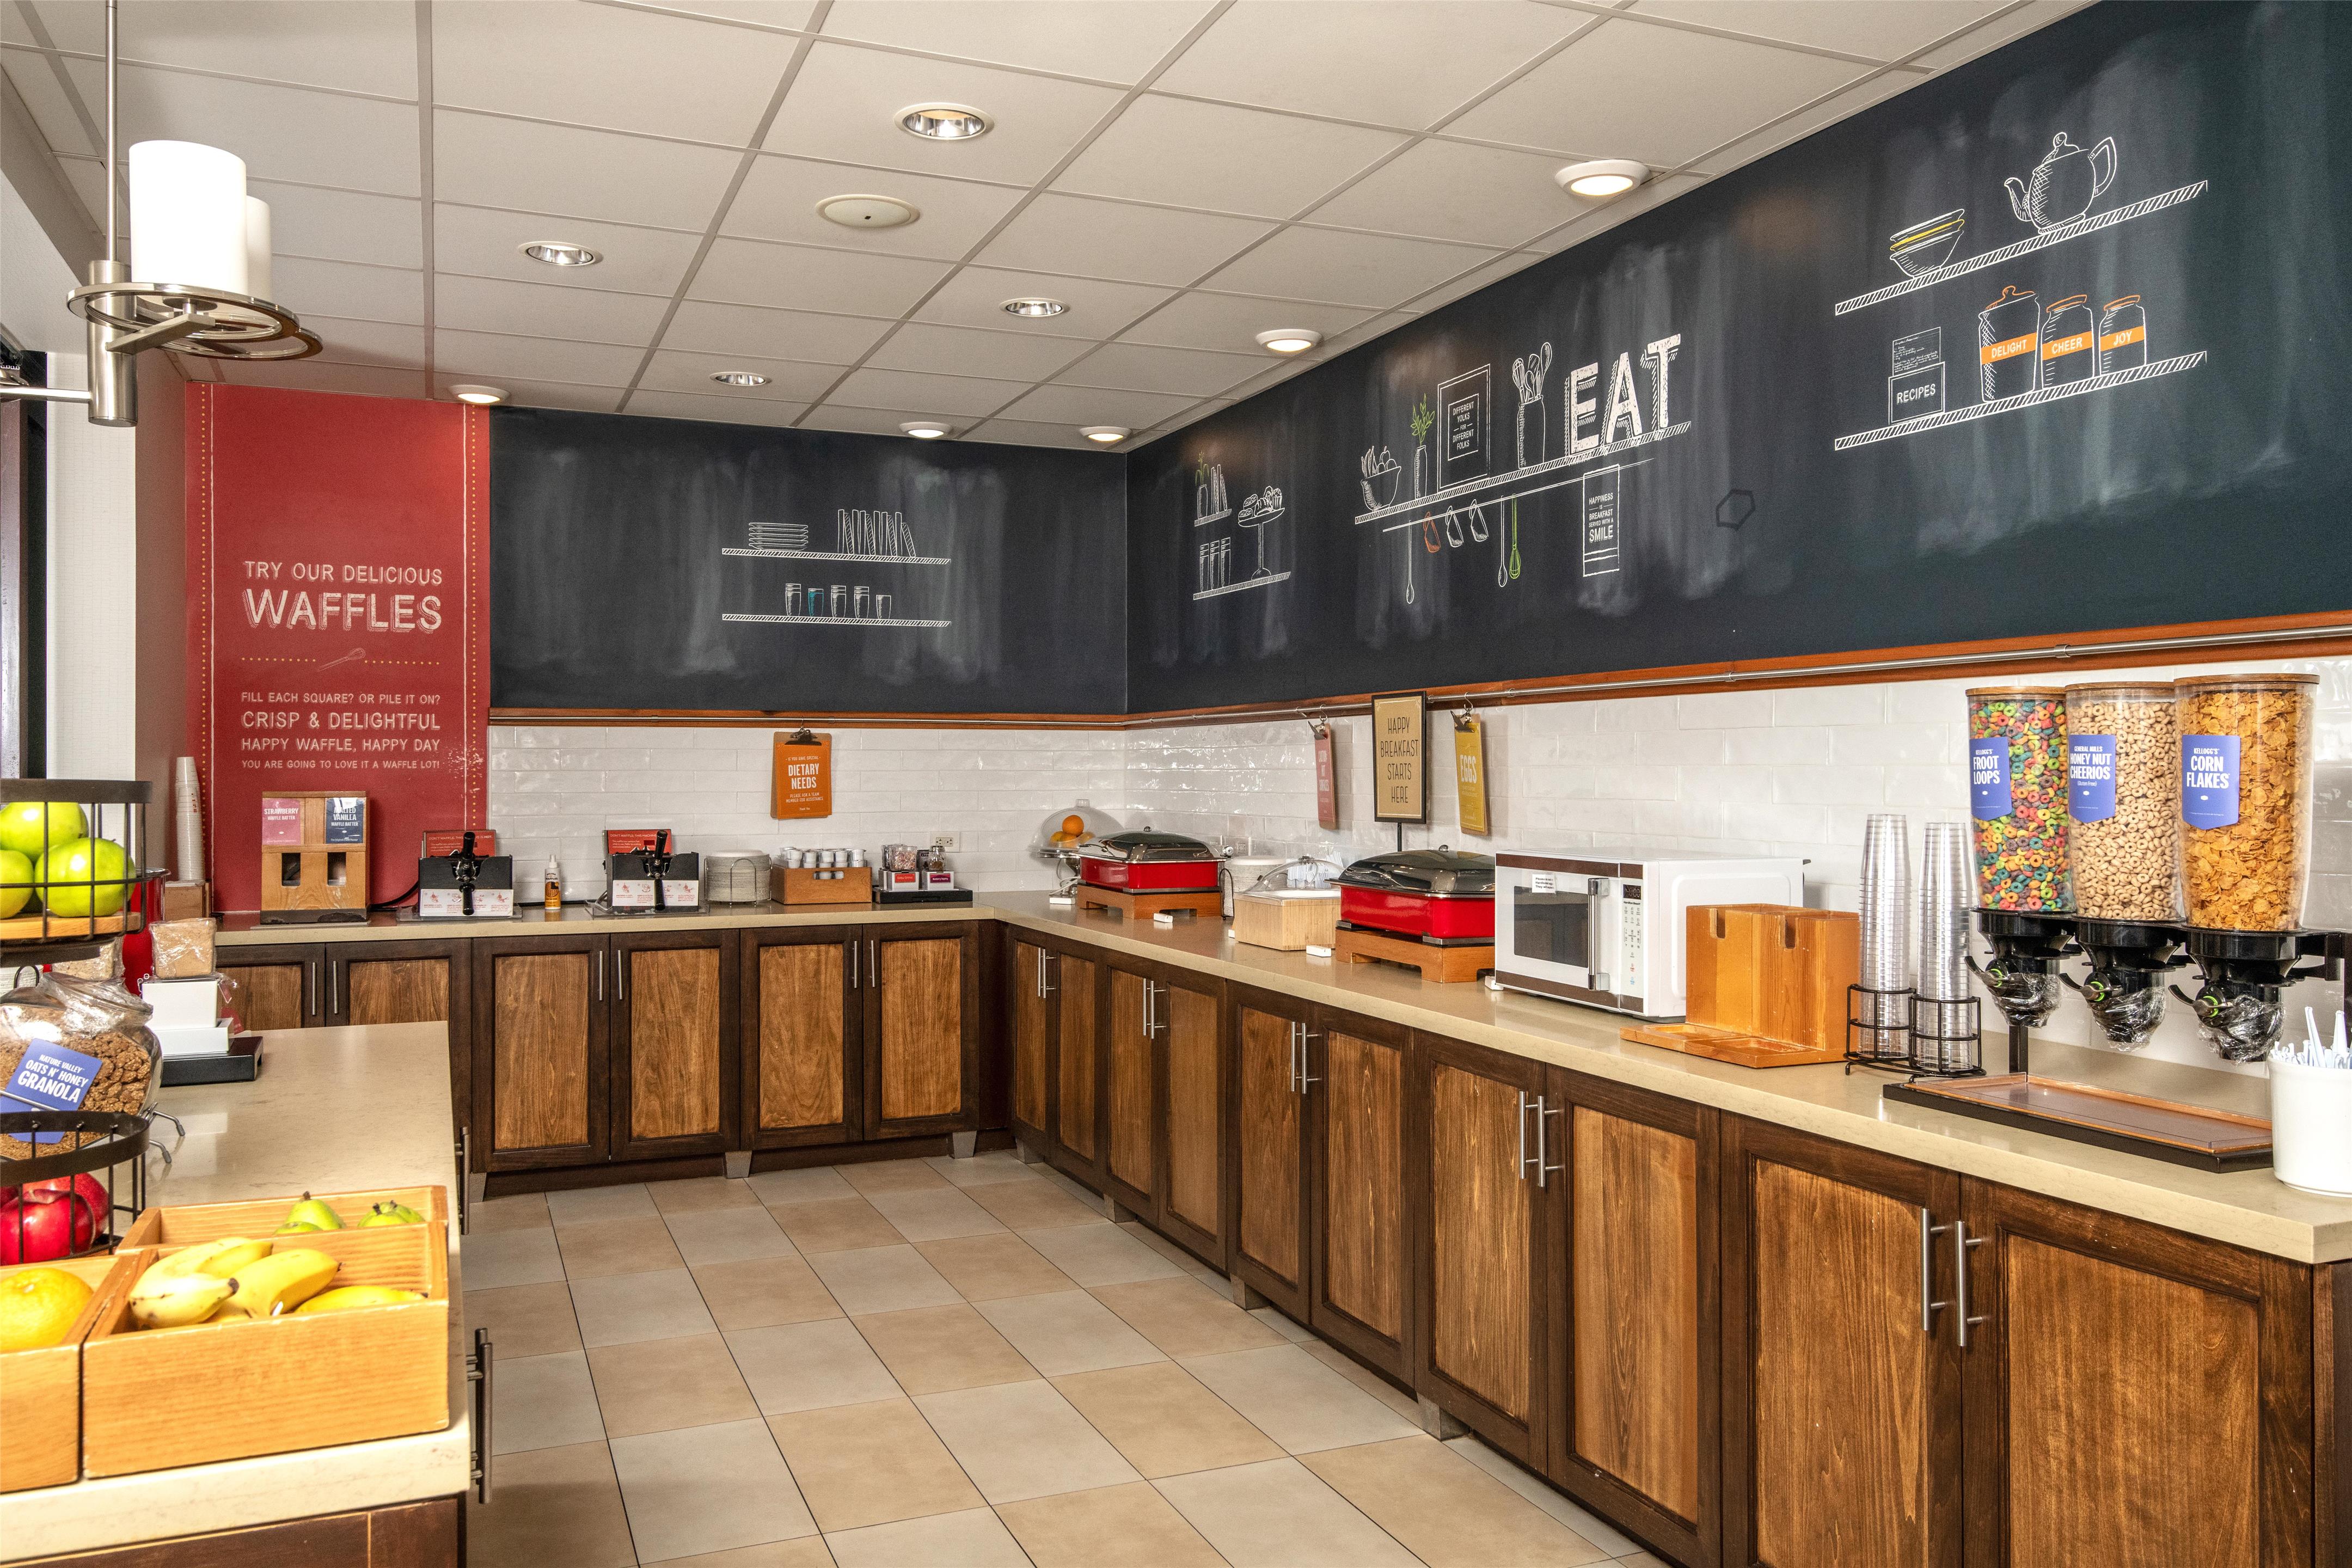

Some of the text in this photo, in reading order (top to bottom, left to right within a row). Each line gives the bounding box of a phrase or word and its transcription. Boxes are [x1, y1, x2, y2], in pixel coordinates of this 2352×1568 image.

[2051, 338, 2082, 354] CHEER
[2114, 332, 2133, 346] JOY
[1991, 339, 2027, 359] DELIGHT
[1565, 333, 1681, 455] EAT
[1896, 383, 1936, 405] RECIPES
[1453, 401, 1474, 415] DIFFERENT
[1457, 412, 1470, 422] YOLKS
[1453, 429, 1474, 443] DIFFERENT
[1457, 440, 1469, 450] FOLKS
[1589, 492, 1613, 505] HAPPINESS
[1589, 509, 1613, 520] BREAKFAST
[1589, 525, 1613, 543] SMILE
[243, 561, 442, 586] TRY OUR DELICIOUS
[242, 589, 442, 634] WAFFLES
[241, 693, 440, 705] FILL EACH SQUARE? OR PILE IT ON?
[242, 711, 440, 731] CRISP & DELIGHTFUL
[1388, 717, 1410, 734] HAPPY
[241, 738, 440, 752] HAPPY WAFFLE, HAPPY DAY
[1380, 739, 1418, 757] BREAKFAST
[242, 760, 261, 768] YOU
[265, 760, 283, 768] ARE
[287, 760, 316, 768] GOING
[320, 760, 331, 768] TO
[335, 761, 358, 769] LOVE
[420, 761, 439, 769] LOT!
[1973, 756, 1999, 770] FROOT
[2070, 753, 2112, 765] HONEY NUT
[2190, 756, 2224, 771] CORN
[788, 763, 819, 776] DIETARY
[1387, 763, 1412, 781] STARTS
[1460, 755, 1477, 783] EGGS
[2070, 765, 2111, 780] CHEERIOS
[791, 776, 817, 789] NEEDS
[1974, 770, 2000, 785] LOOPS
[2186, 772, 2229, 789] FLAKES
[1391, 786, 1408, 804] HERE
[39, 1054, 83, 1074] NATURE VALLEY
[26, 1059, 89, 1087] OATS N' HONEY
[18, 1070, 81, 1103] GRANOLA
